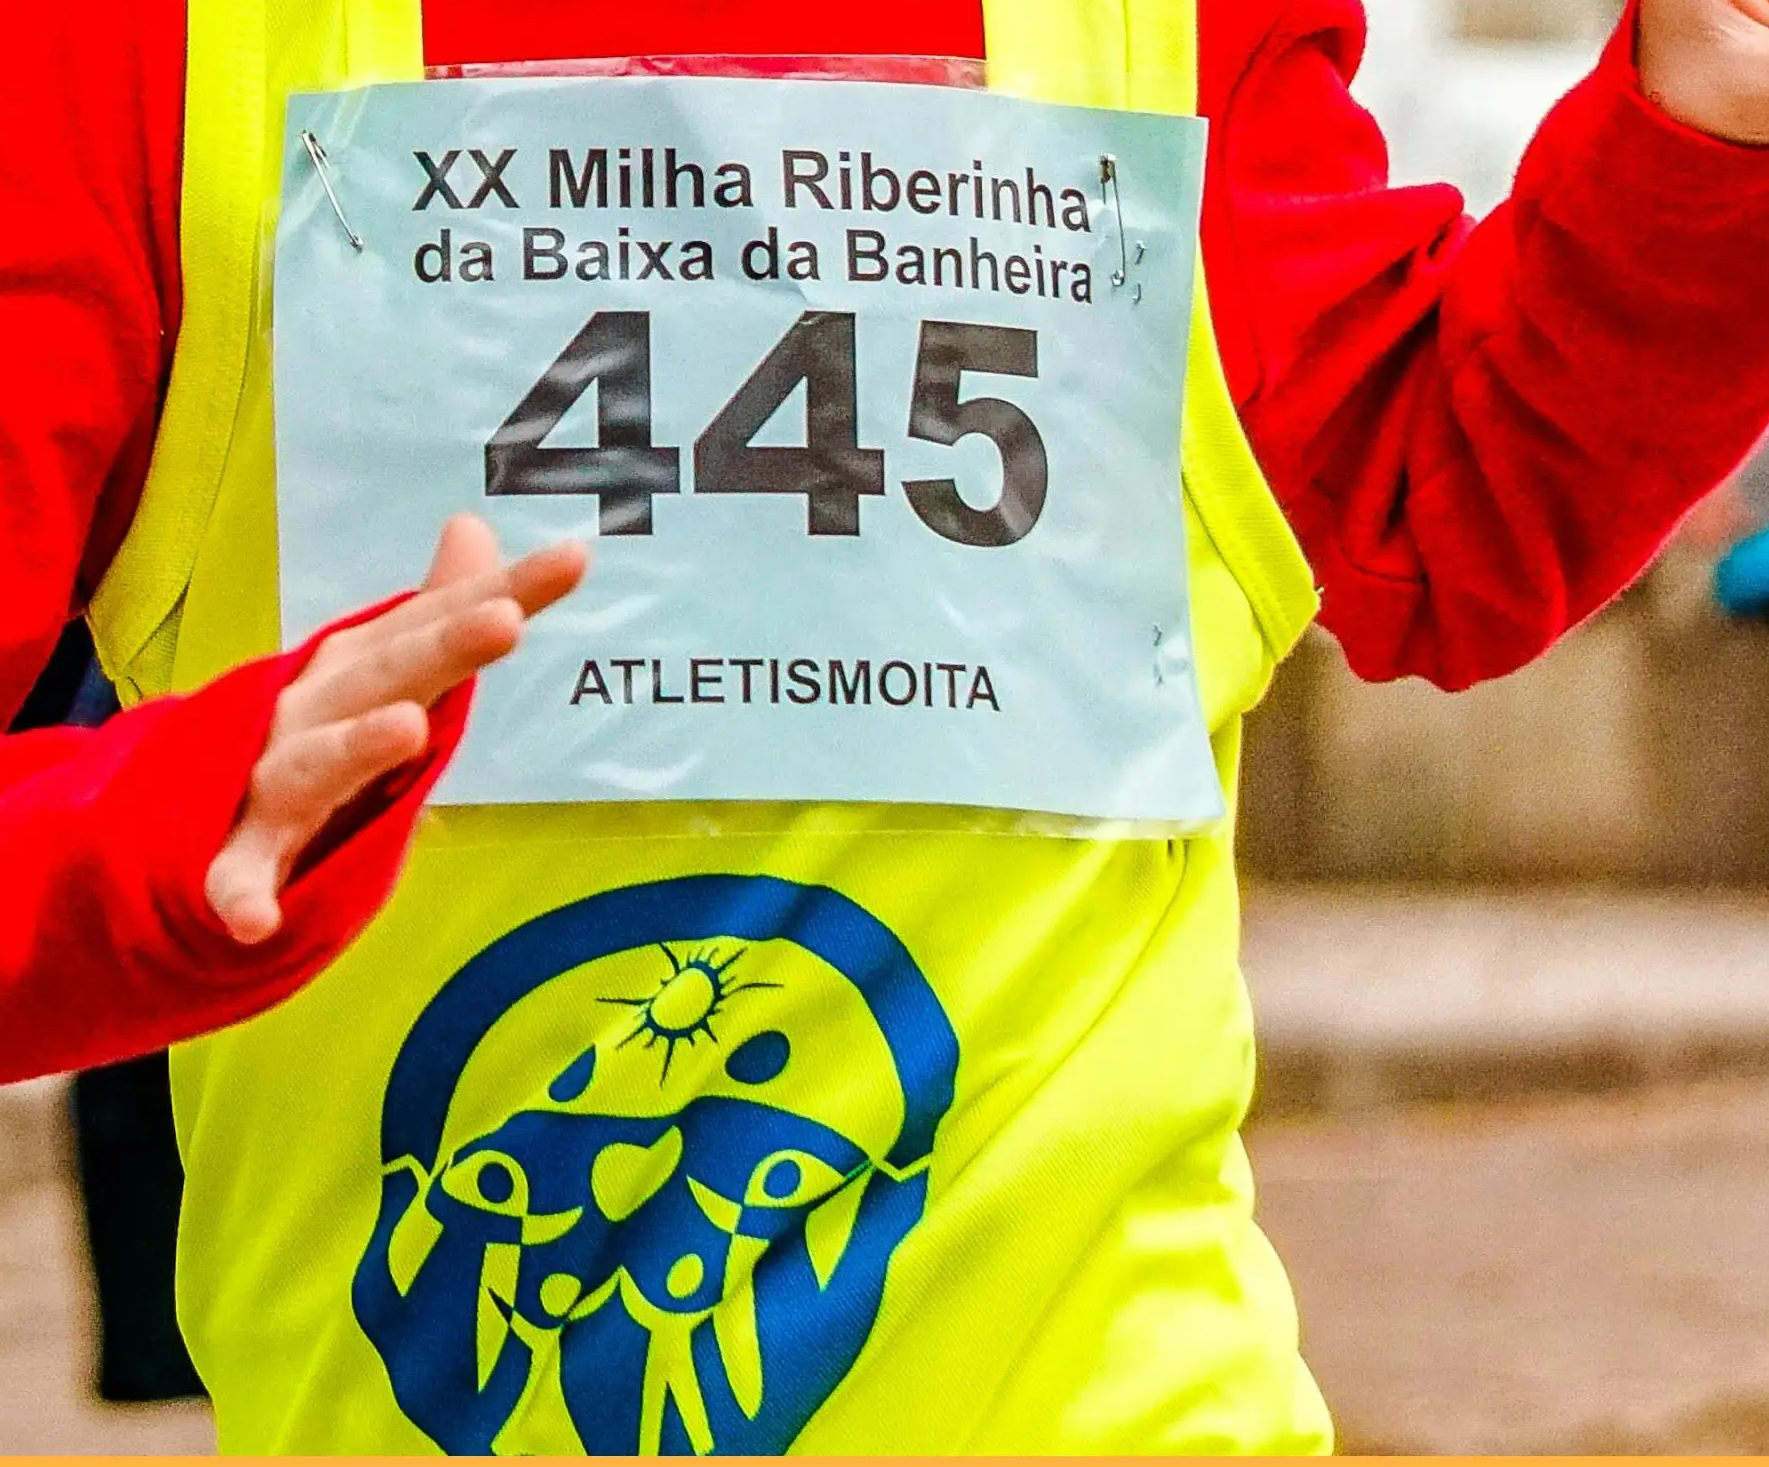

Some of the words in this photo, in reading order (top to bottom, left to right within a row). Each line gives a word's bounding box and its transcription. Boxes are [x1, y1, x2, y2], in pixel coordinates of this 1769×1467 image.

[411, 147, 521, 212] XX
[547, 147, 754, 209] Milha
[781, 149, 1092, 233] Riberinha
[413, 227, 495, 283] da
[522, 226, 715, 282] Baixa
[740, 225, 821, 281] da
[845, 228, 1093, 305] Banheira
[484, 310, 1049, 548] 445
[569, 655, 1001, 714] ATLETISMOITA
